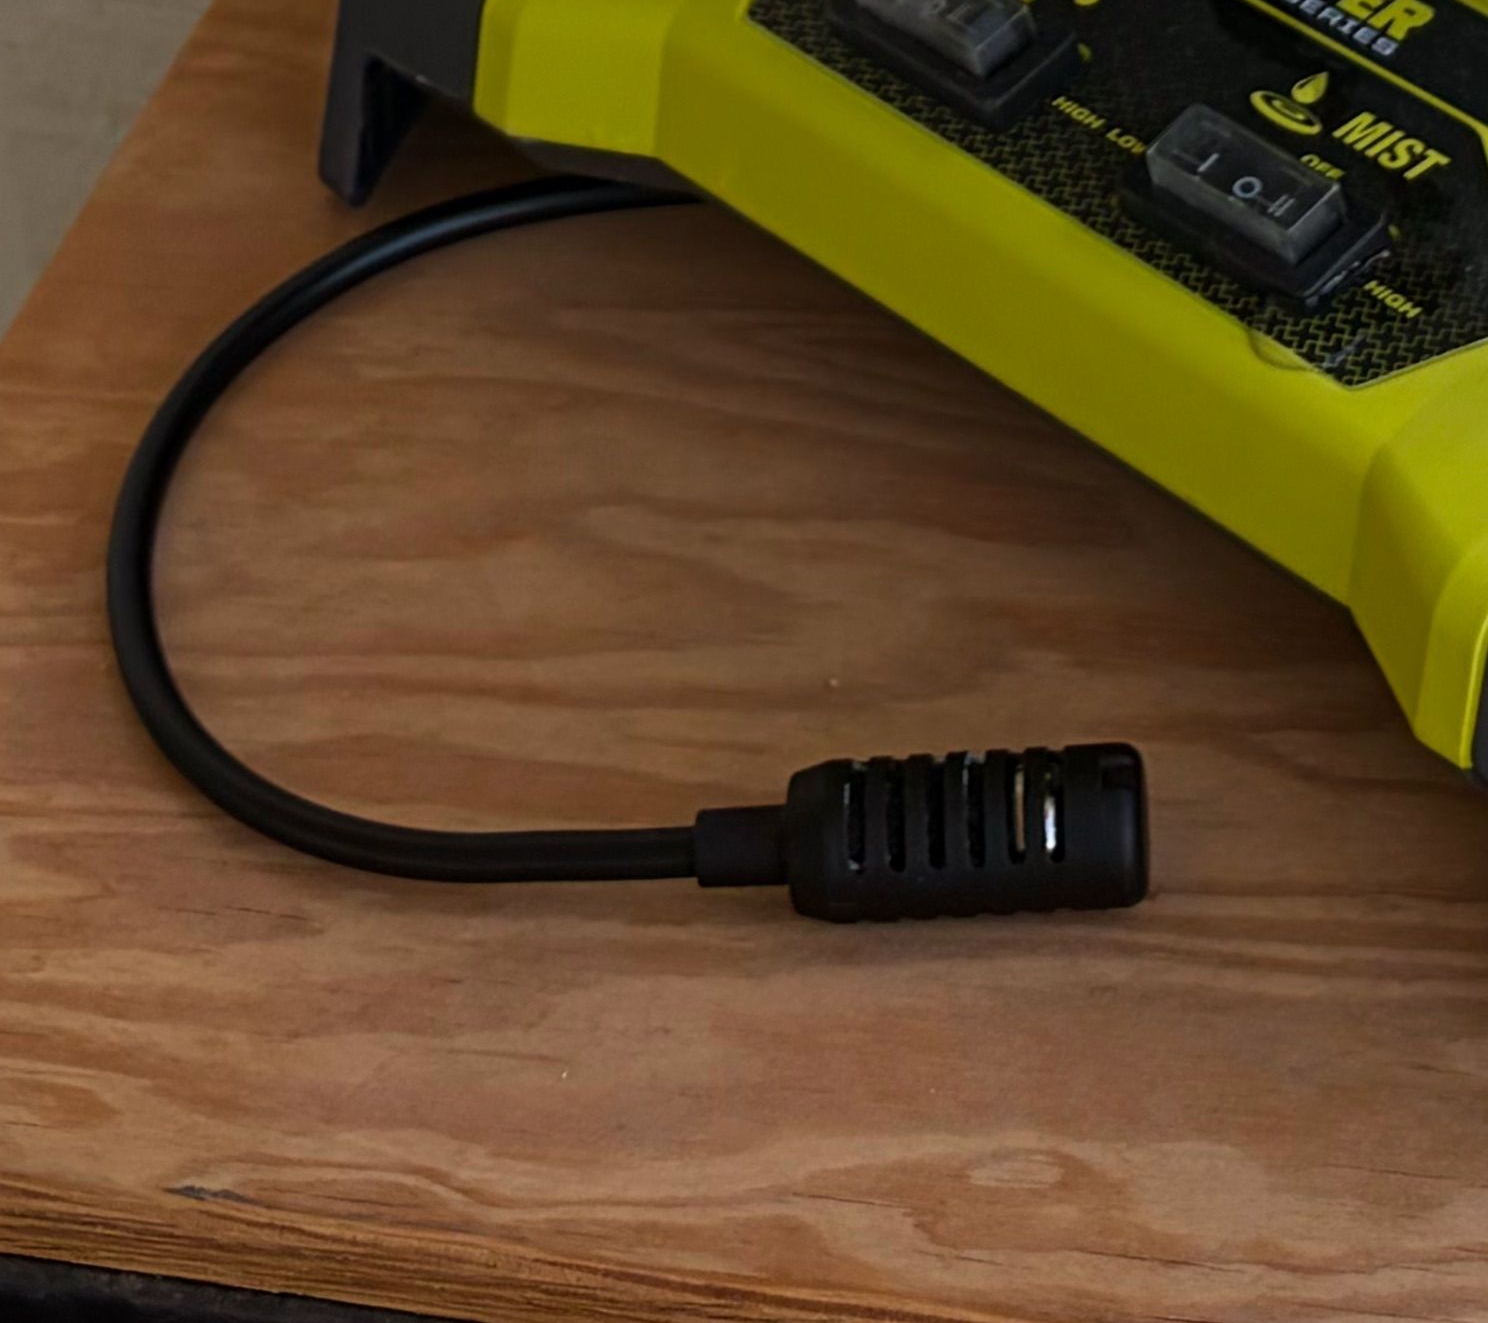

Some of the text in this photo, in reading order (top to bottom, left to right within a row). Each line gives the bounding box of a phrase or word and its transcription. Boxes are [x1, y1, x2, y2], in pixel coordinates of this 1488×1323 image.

[1051, 95, 1107, 130] HIGH
[1331, 111, 1452, 181] MIST
[1363, 279, 1424, 319] HIGH
